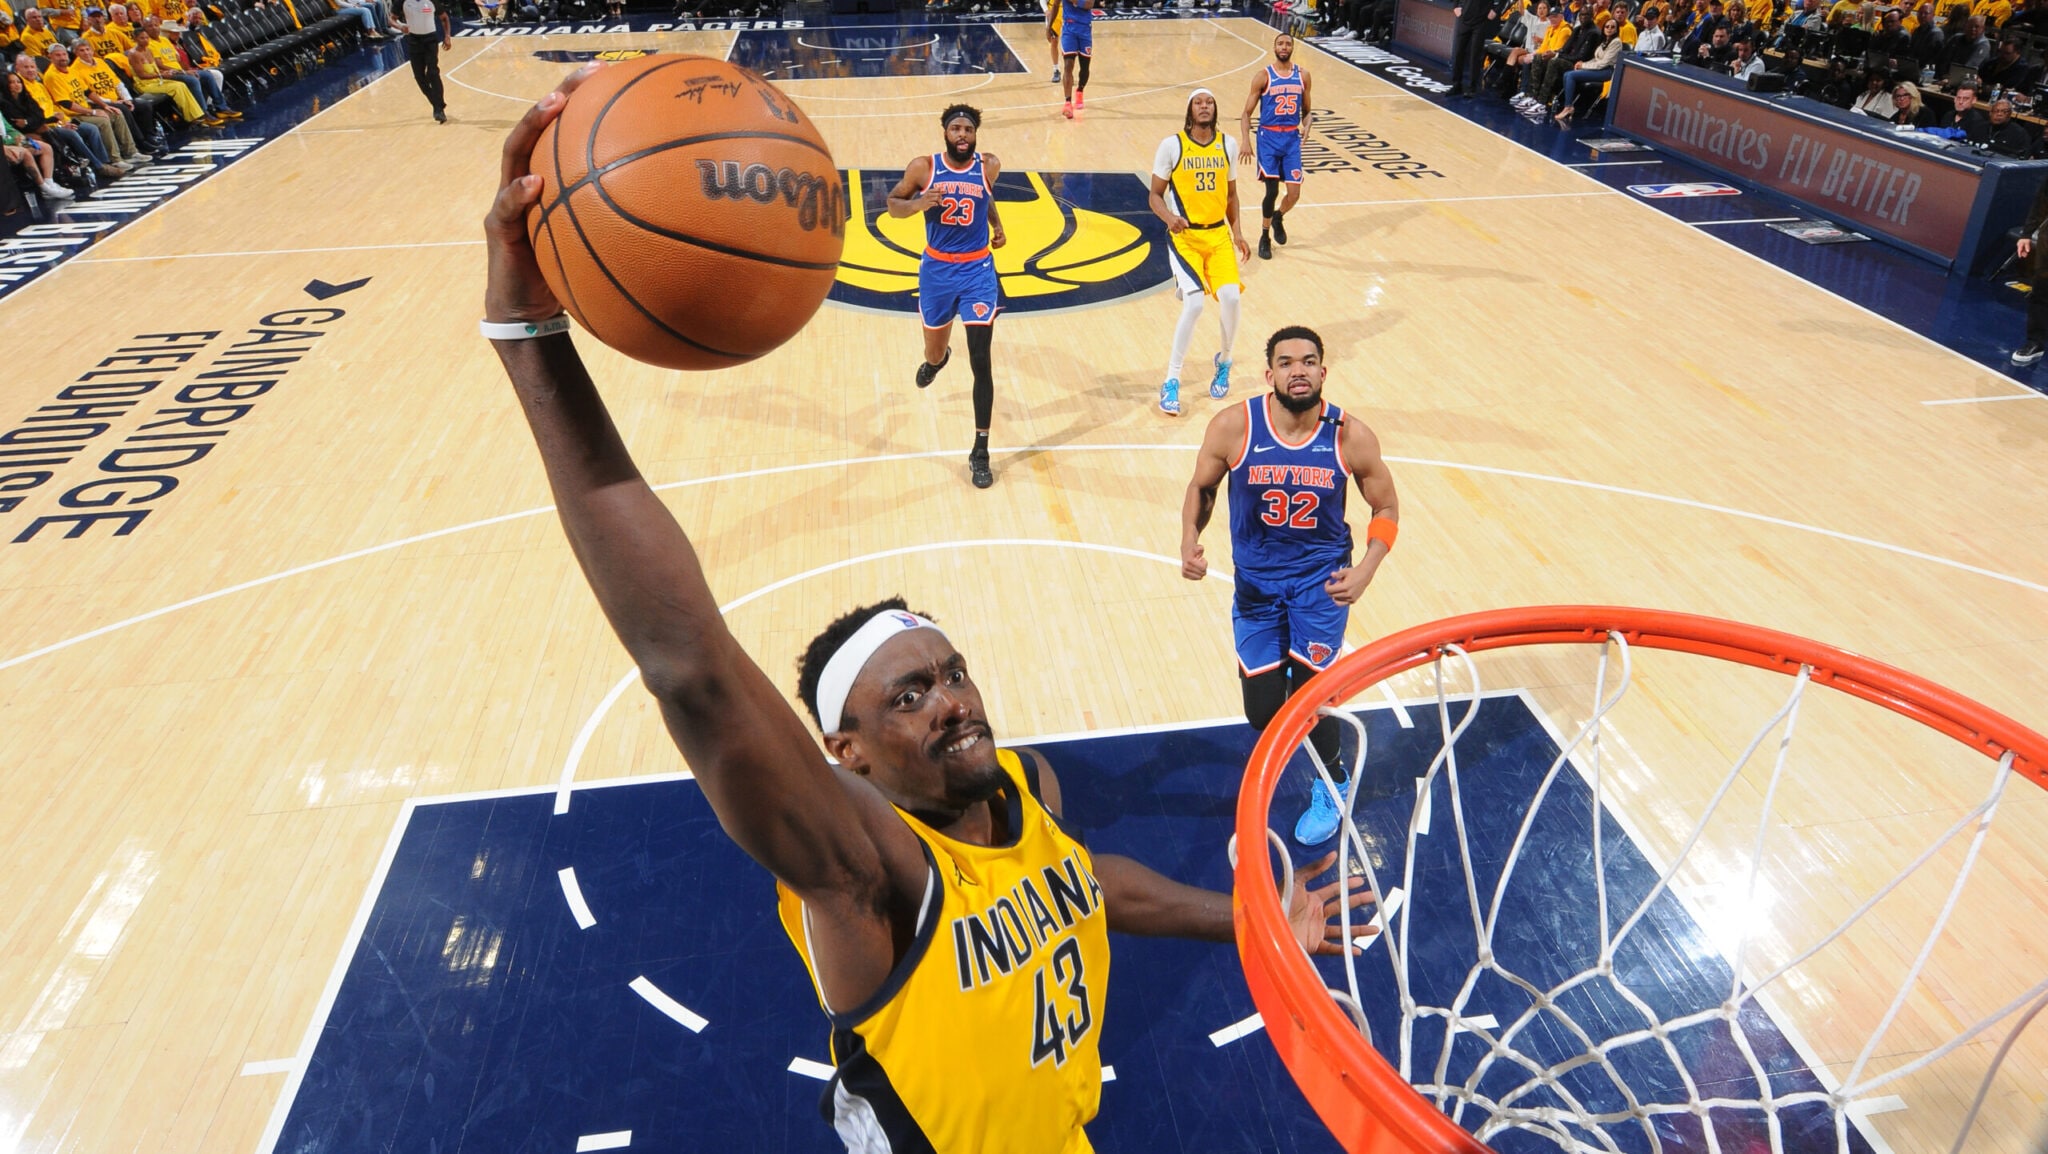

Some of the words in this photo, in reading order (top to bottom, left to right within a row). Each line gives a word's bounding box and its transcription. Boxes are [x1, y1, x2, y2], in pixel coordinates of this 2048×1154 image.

[454, 24, 631, 38] INDIANA
[647, 20, 805, 32] PACERS
[90, 71, 109, 81] YES
[1385, 66, 1453, 93] Google
[1274, 95, 1298, 115] 25
[161, 137, 265, 160] WE
[1646, 87, 1771, 170] Emirates
[1779, 134, 1827, 188] FLY
[1820, 147, 1922, 226] BETTER
[1183, 156, 1225, 170] INDIANA
[55, 163, 218, 214] GROW
[957, 182, 984, 199] YORK
[1195, 171, 1217, 191] 33
[941, 197, 975, 226] 23
[0, 330, 223, 513] FIELDHOU
[10, 307, 346, 544] GAINBRIDGE
[1248, 465, 1290, 485] NEW
[1289, 465, 1335, 489] YORK
[1261, 488, 1320, 529] 32
[952, 848, 1104, 992] INDIANA
[1030, 935, 1092, 1070] 43
